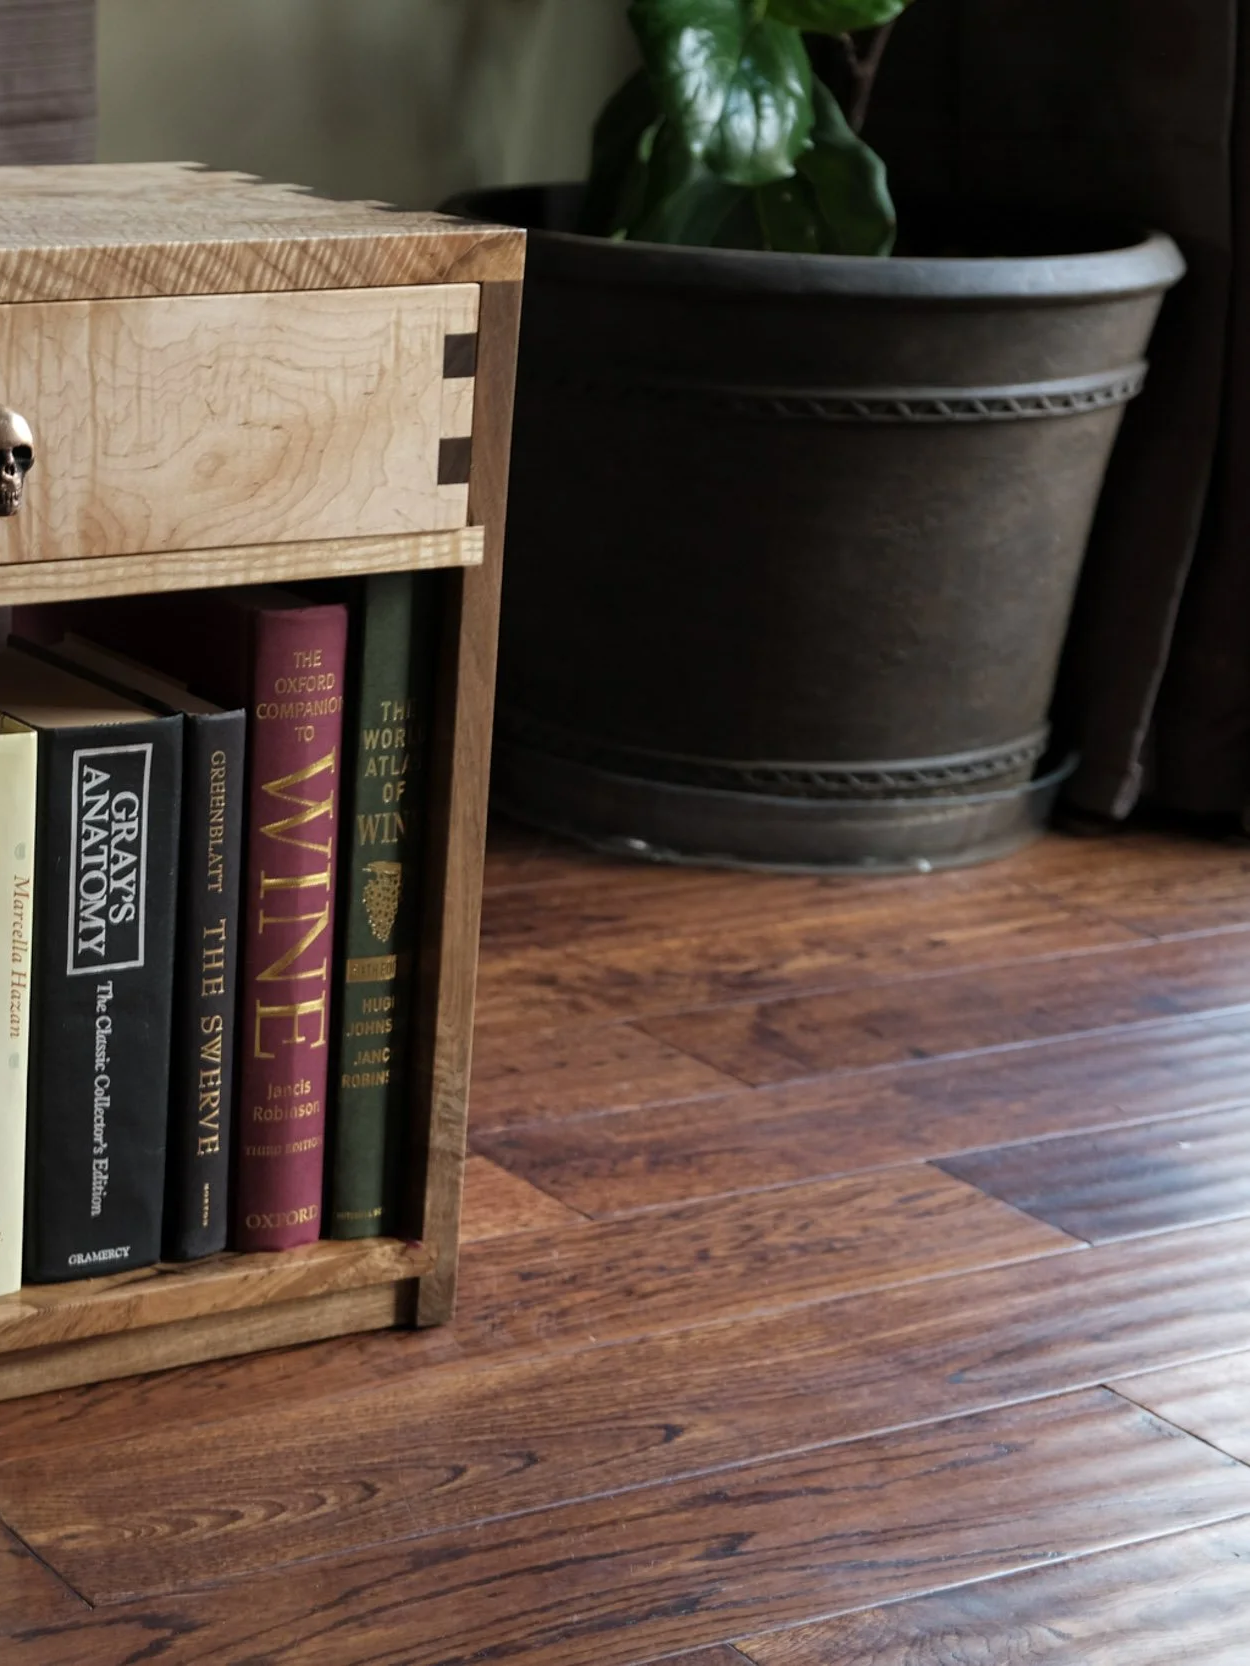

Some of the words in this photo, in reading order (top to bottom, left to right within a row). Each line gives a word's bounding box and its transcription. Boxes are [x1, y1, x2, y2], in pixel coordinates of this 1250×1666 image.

[275, 673, 335, 695] OXFORD
[294, 649, 322, 669] THE
[295, 725, 315, 743] TO
[206, 749, 227, 893] GREENBLATT
[382, 781, 406, 804] OF
[77, 764, 111, 957] ANATOMY
[108, 790, 139, 926] GRAY'S
[11, 875, 31, 964] Marcella
[254, 745, 336, 1059] WINE
[201, 919, 227, 997] THE
[9, 969, 28, 1039] Hazan
[96, 980, 113, 1013] The
[95, 1015, 112, 1072] Classic
[197, 1013, 224, 1157] SWERVE
[253, 1100, 321, 1124] Robinson
[266, 1078, 311, 1101] Jancis
[93, 1073, 112, 1156] Collector's
[90, 1157, 109, 1217] Edition
[246, 1205, 318, 1229] OXFORD
[68, 1246, 131, 1266] GRAMERCY
